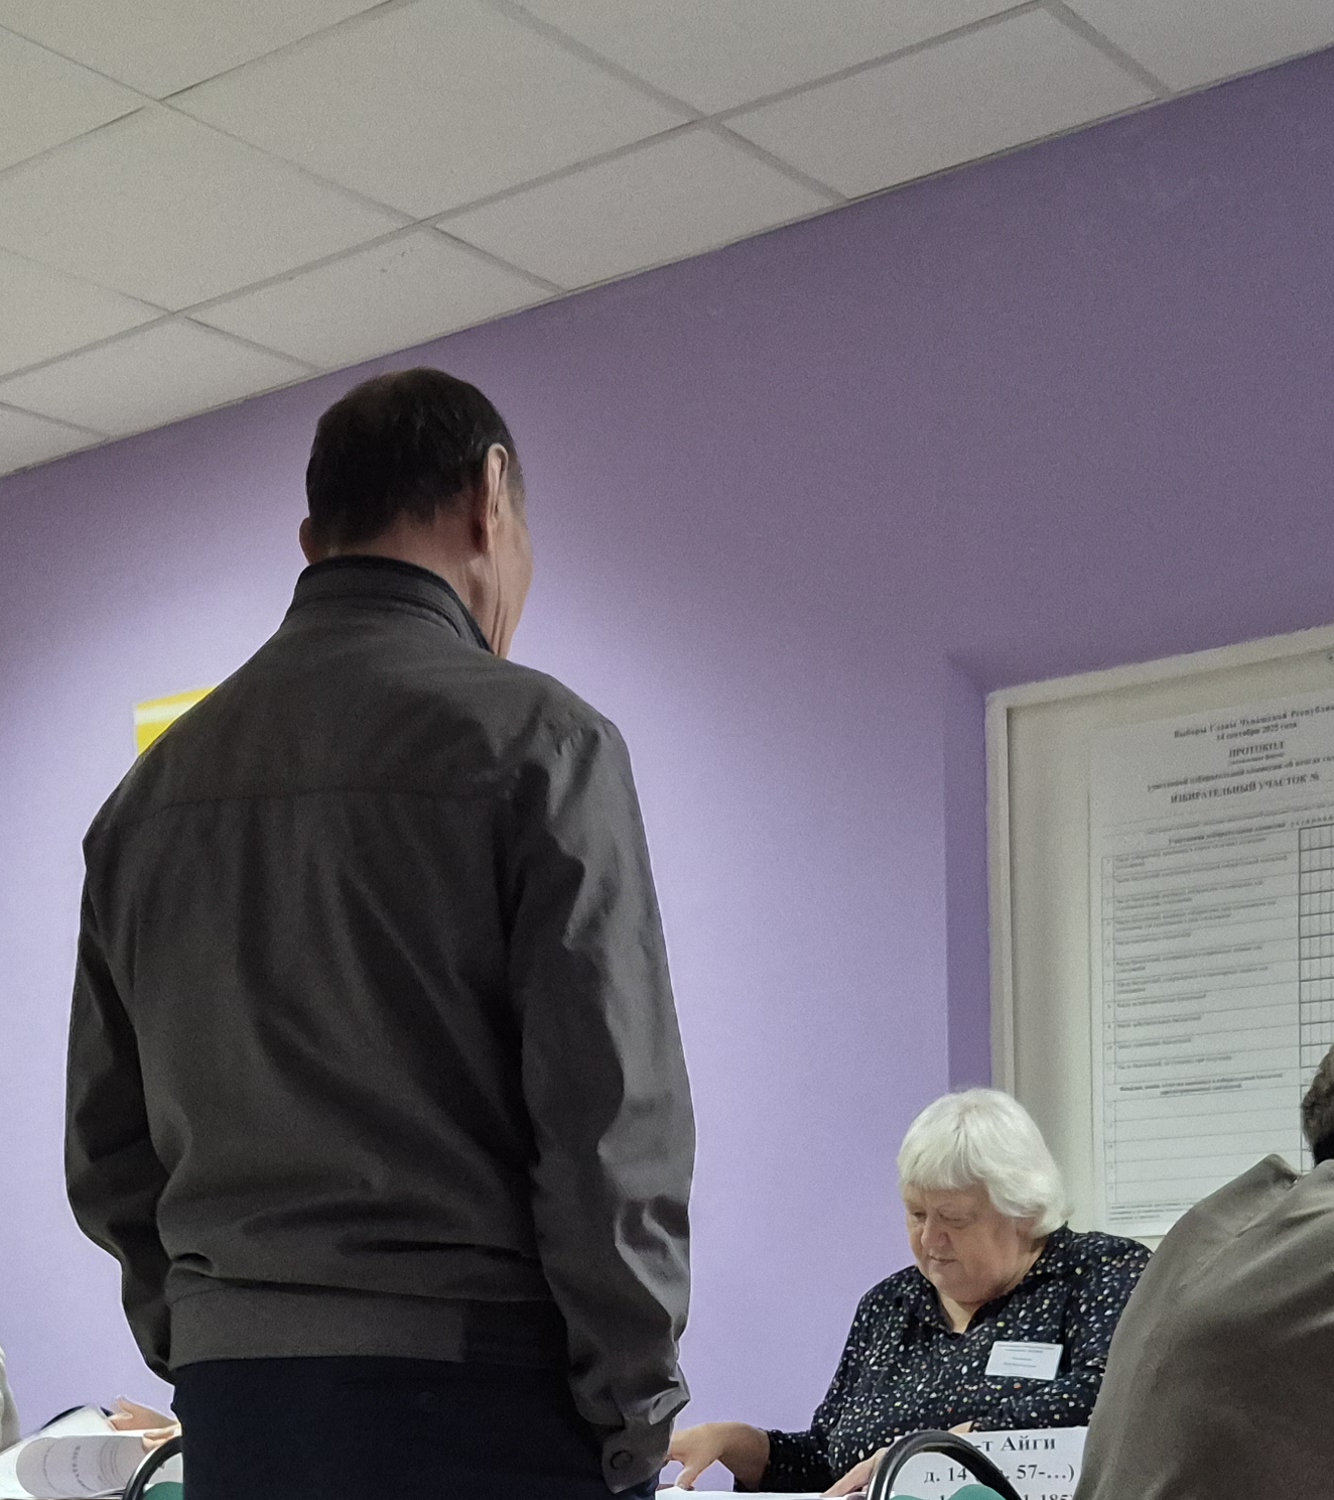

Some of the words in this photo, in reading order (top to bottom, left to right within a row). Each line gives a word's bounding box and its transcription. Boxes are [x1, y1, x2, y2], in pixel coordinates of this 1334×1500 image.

[1000, 1435, 1056, 1451] Айги
[924, 1472, 941, 1483] д.
[949, 1467, 967, 1481] 14
